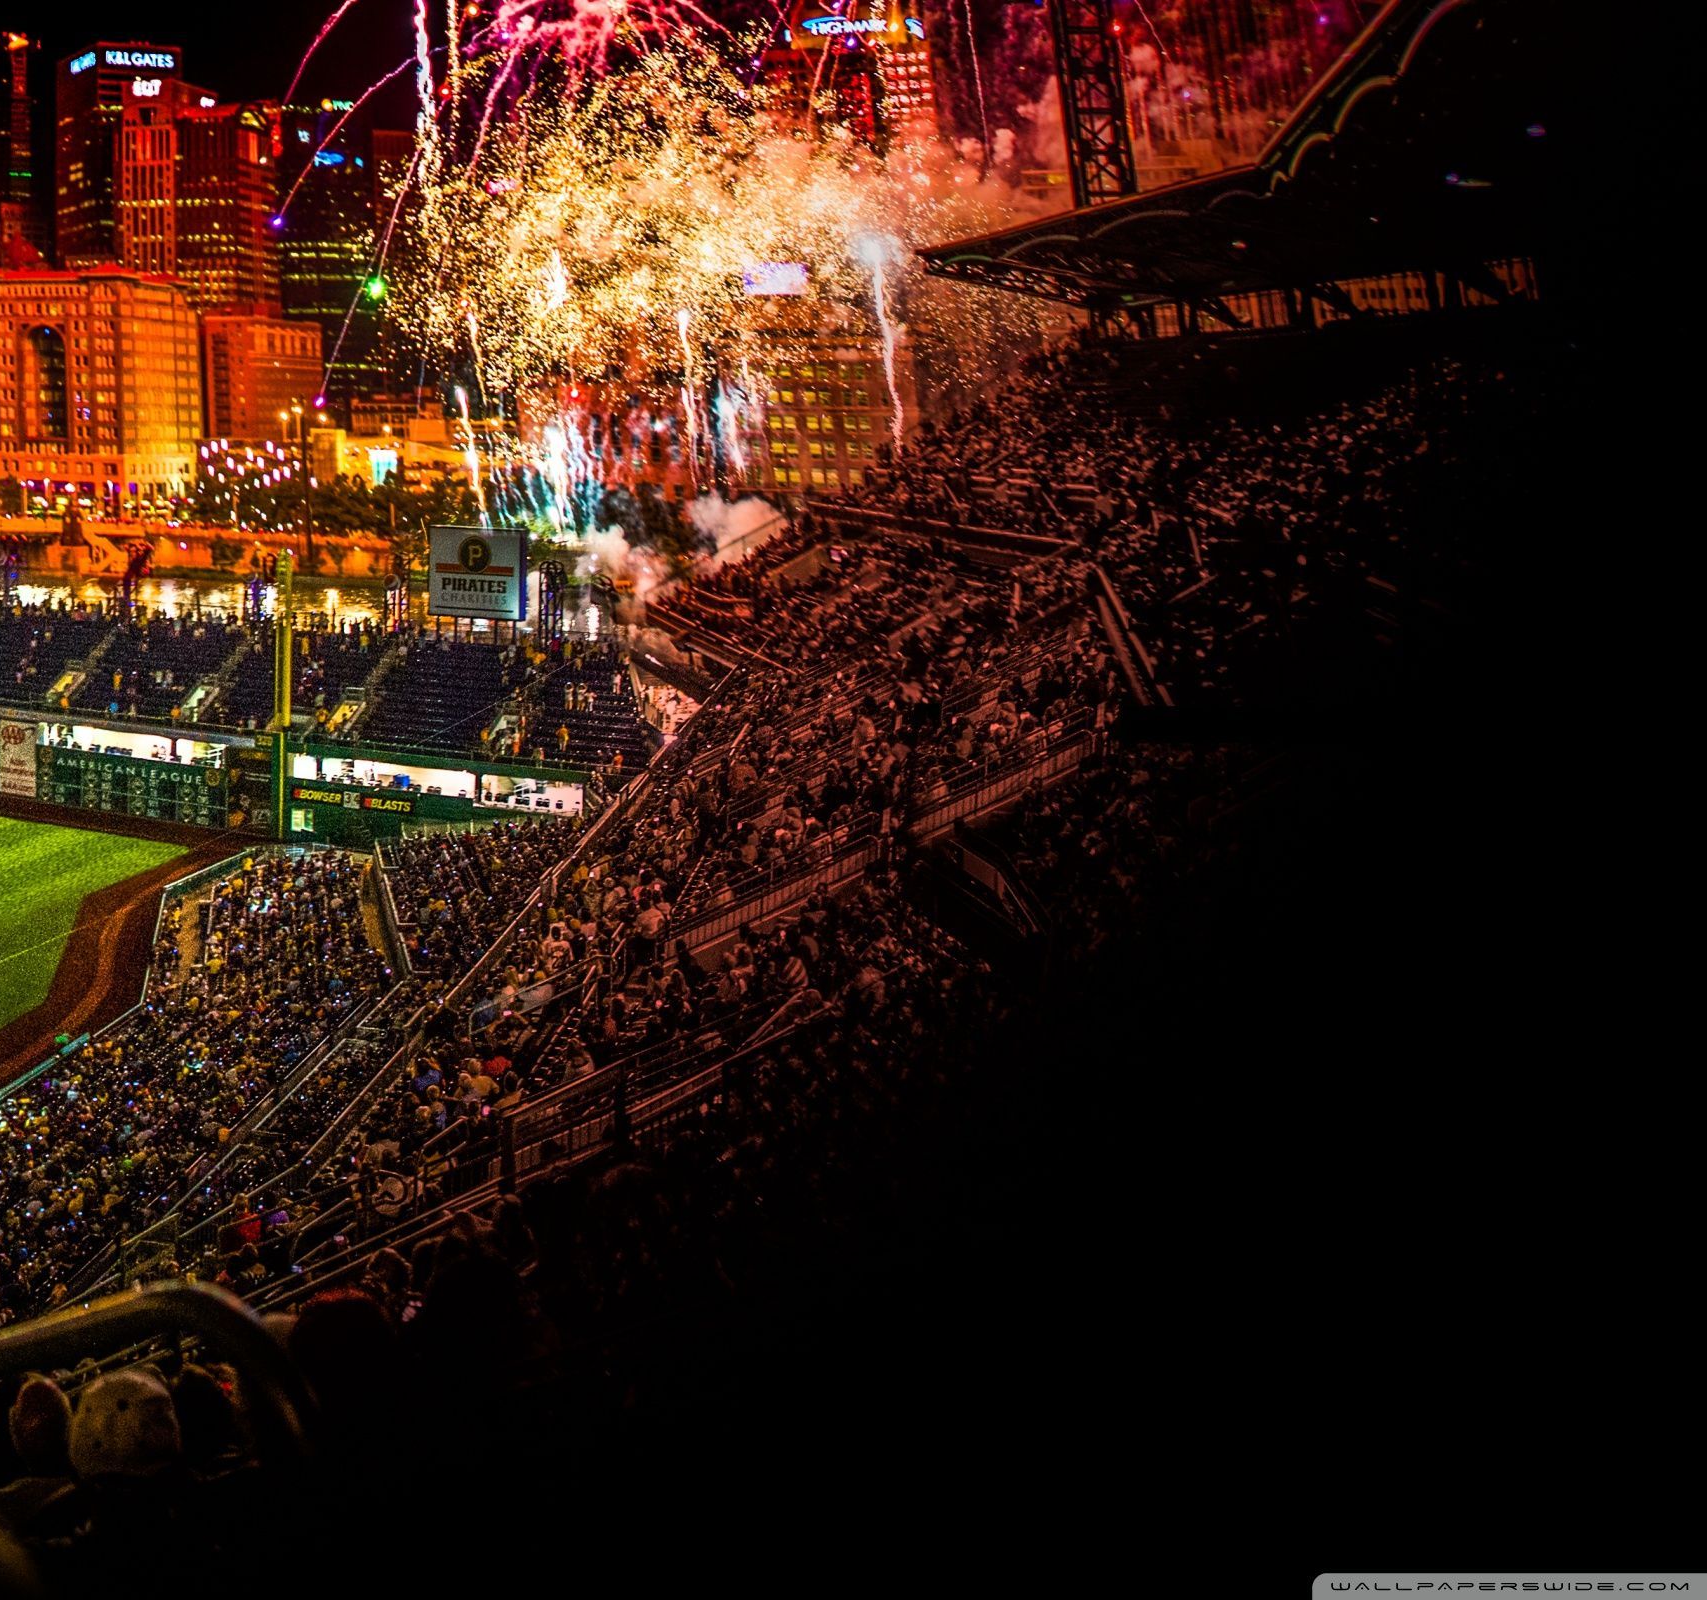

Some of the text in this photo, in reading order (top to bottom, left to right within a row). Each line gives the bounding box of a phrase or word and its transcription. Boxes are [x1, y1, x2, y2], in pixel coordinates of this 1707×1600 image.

[130, 53, 174, 68] GATES
[468, 545, 482, 566] P
[441, 577, 507, 594] PIRATES
[57, 757, 203, 784] AMERICAN LEAGUE
[299, 789, 342, 803] BOWSER
[371, 798, 411, 812] BLASTS
